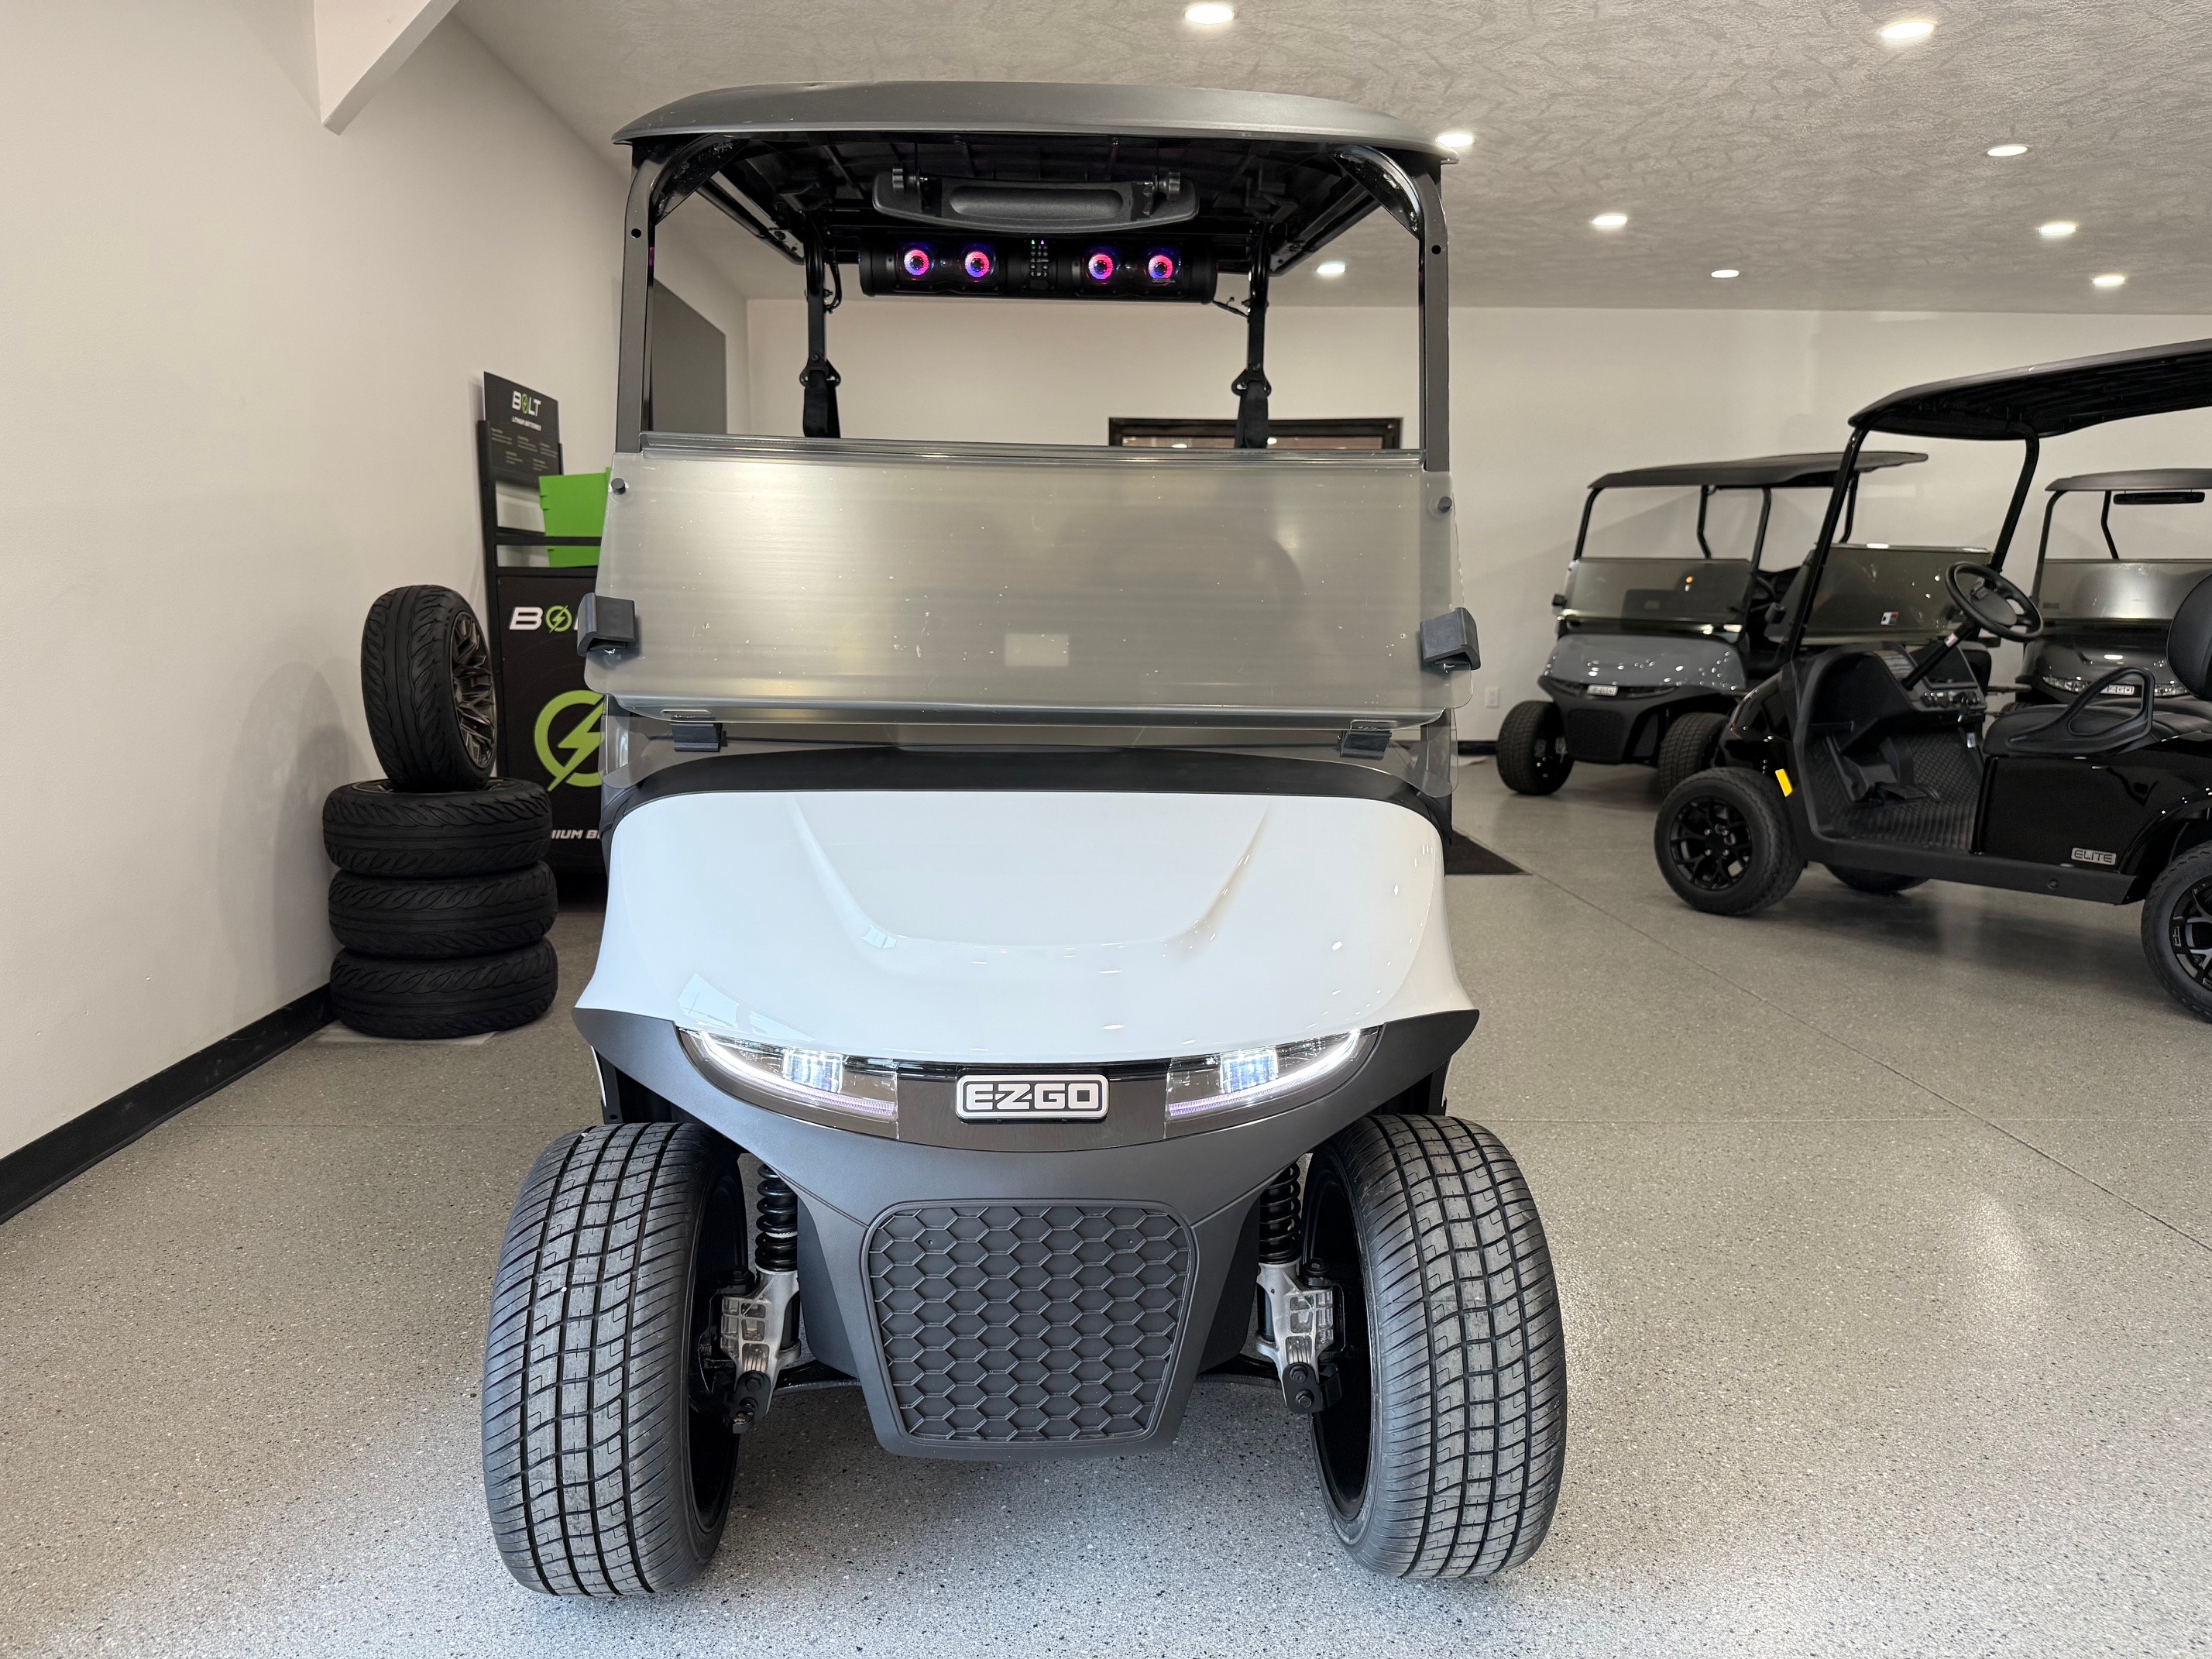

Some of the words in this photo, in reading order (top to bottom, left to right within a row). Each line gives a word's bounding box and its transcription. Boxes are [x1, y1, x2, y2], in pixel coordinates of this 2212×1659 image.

[512, 390, 541, 417] BOLT
[510, 605, 578, 633] BO
[586, 830, 599, 839] B
[2074, 850, 2113, 864] ELITE
[966, 1083, 1099, 1111] EZGO
